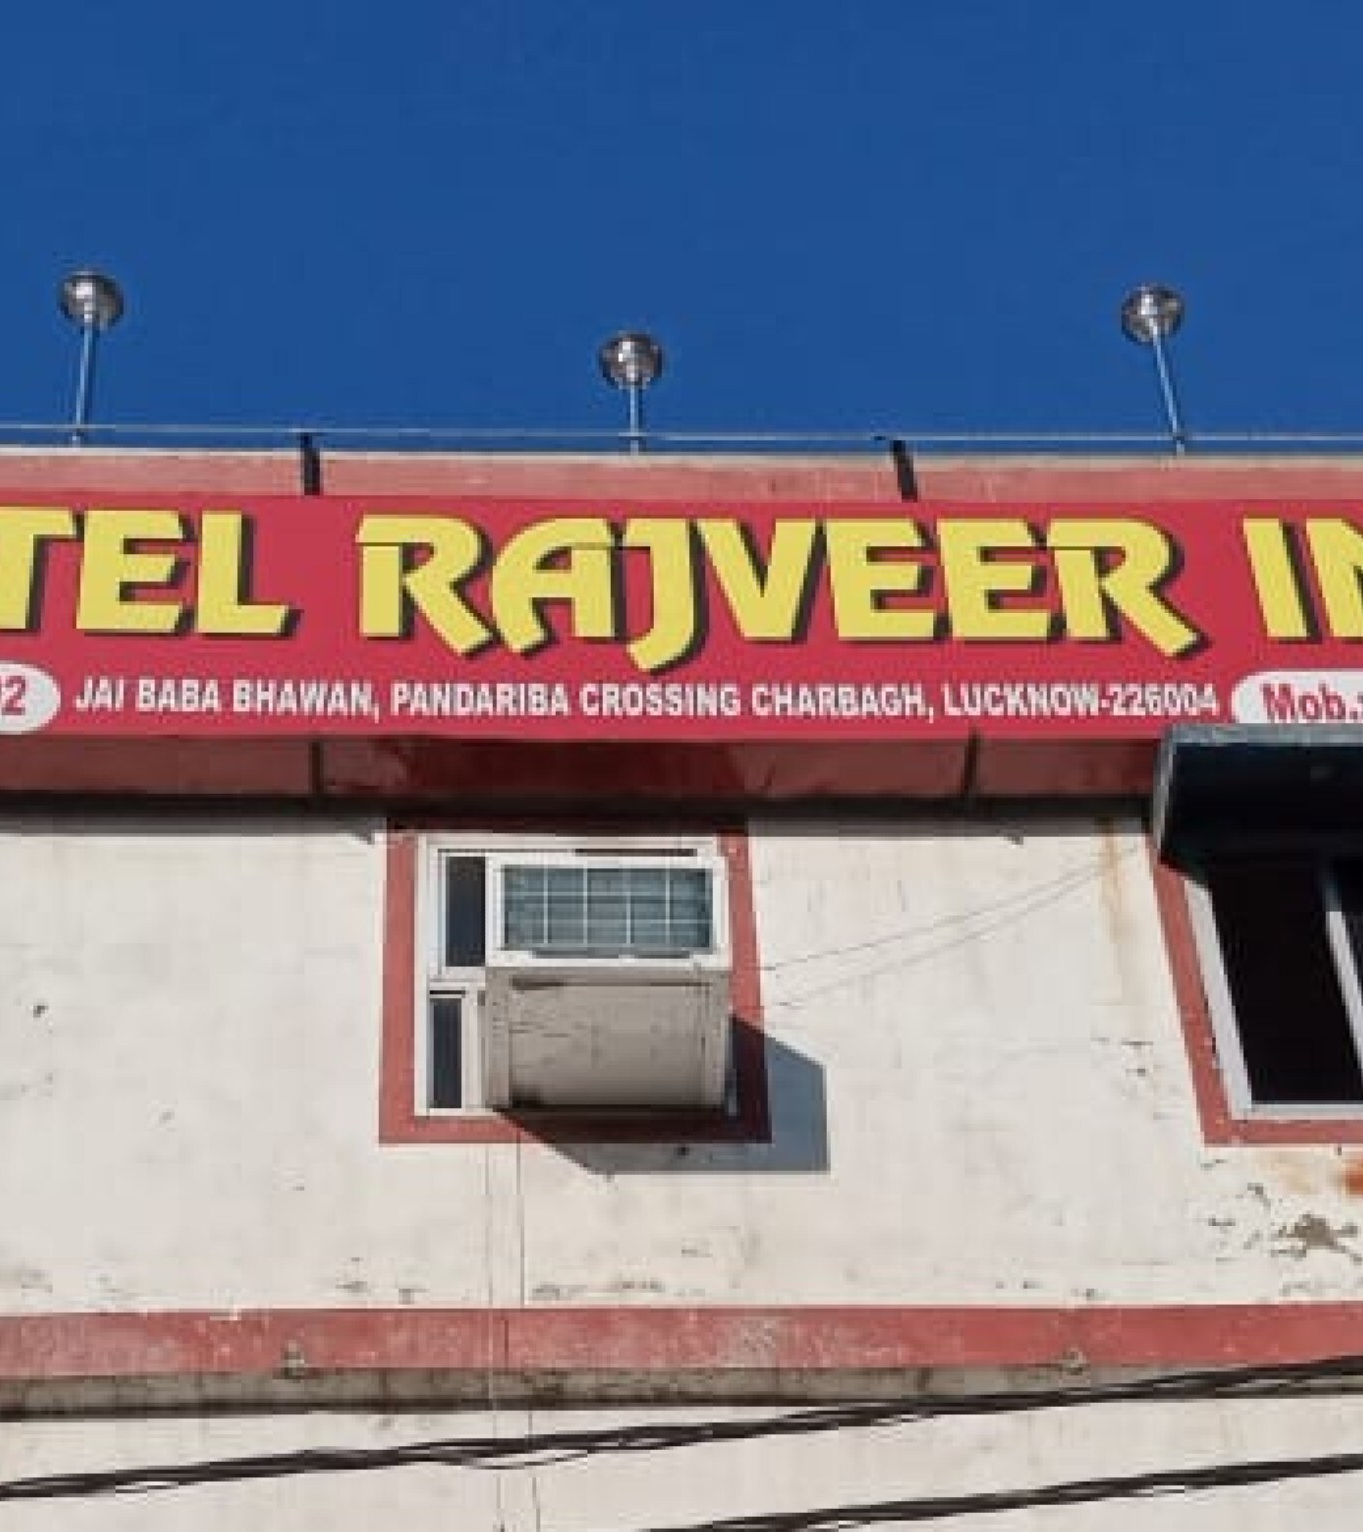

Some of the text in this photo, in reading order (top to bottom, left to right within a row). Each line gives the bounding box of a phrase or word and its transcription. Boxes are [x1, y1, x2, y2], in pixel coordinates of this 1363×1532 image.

[356, 514, 1205, 672] RAJVEER
[76, 677, 1219, 723] JAI BABA BHAWAN, PANDARIBA CROSSING CHARBAGH, LUCKNOW-226004
